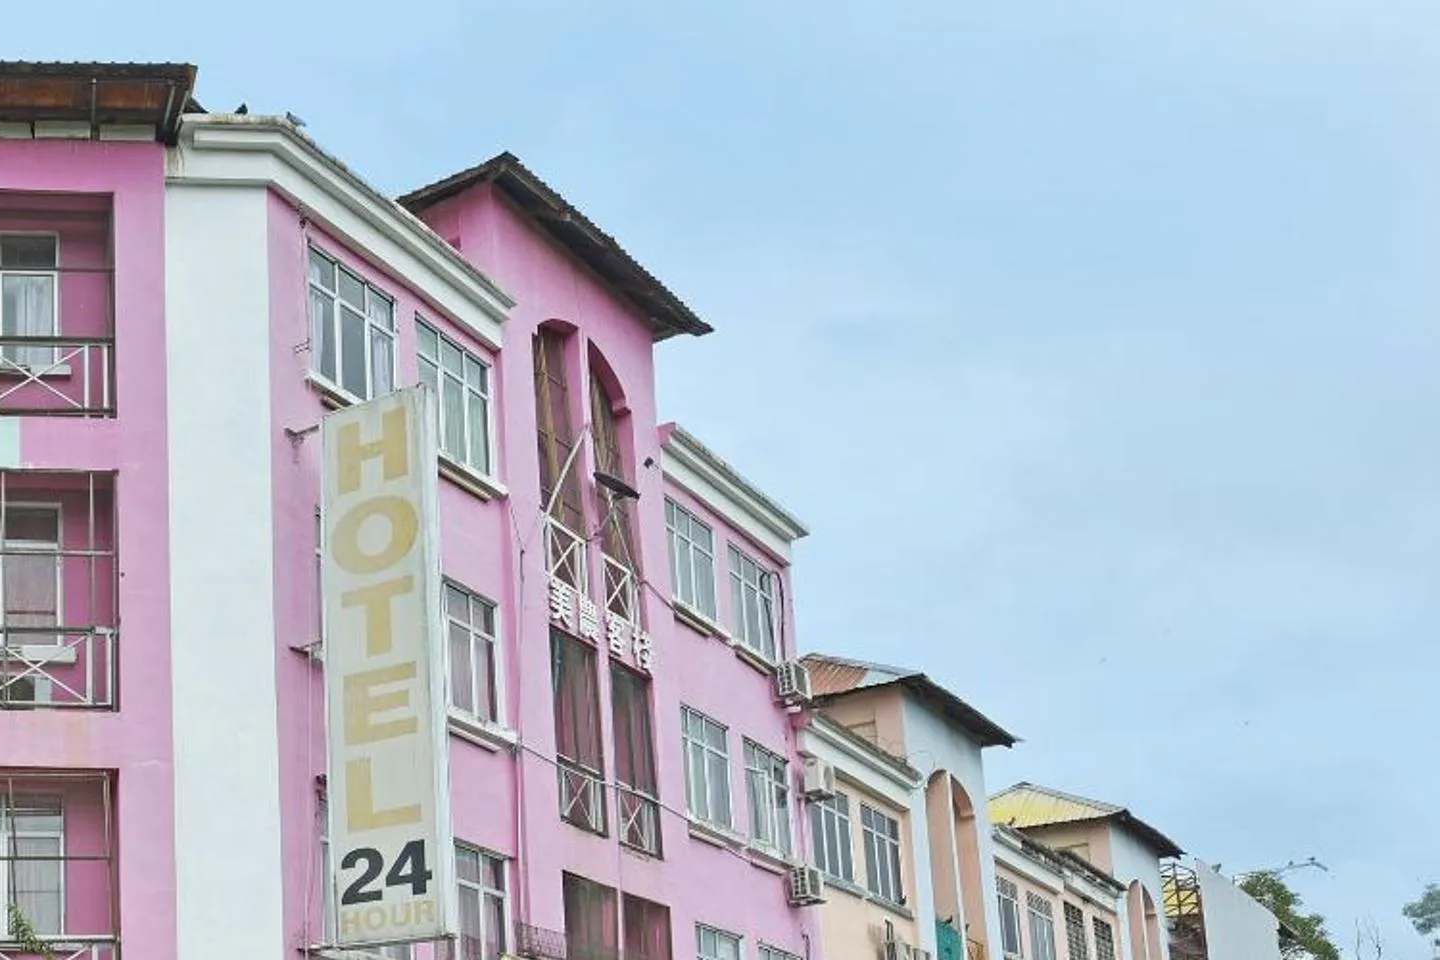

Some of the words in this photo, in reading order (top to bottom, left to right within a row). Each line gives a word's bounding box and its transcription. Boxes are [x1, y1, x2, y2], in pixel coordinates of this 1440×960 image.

[330, 405, 423, 835] HOTEL
[340, 839, 433, 906] 24
[340, 899, 436, 935] HOUR
